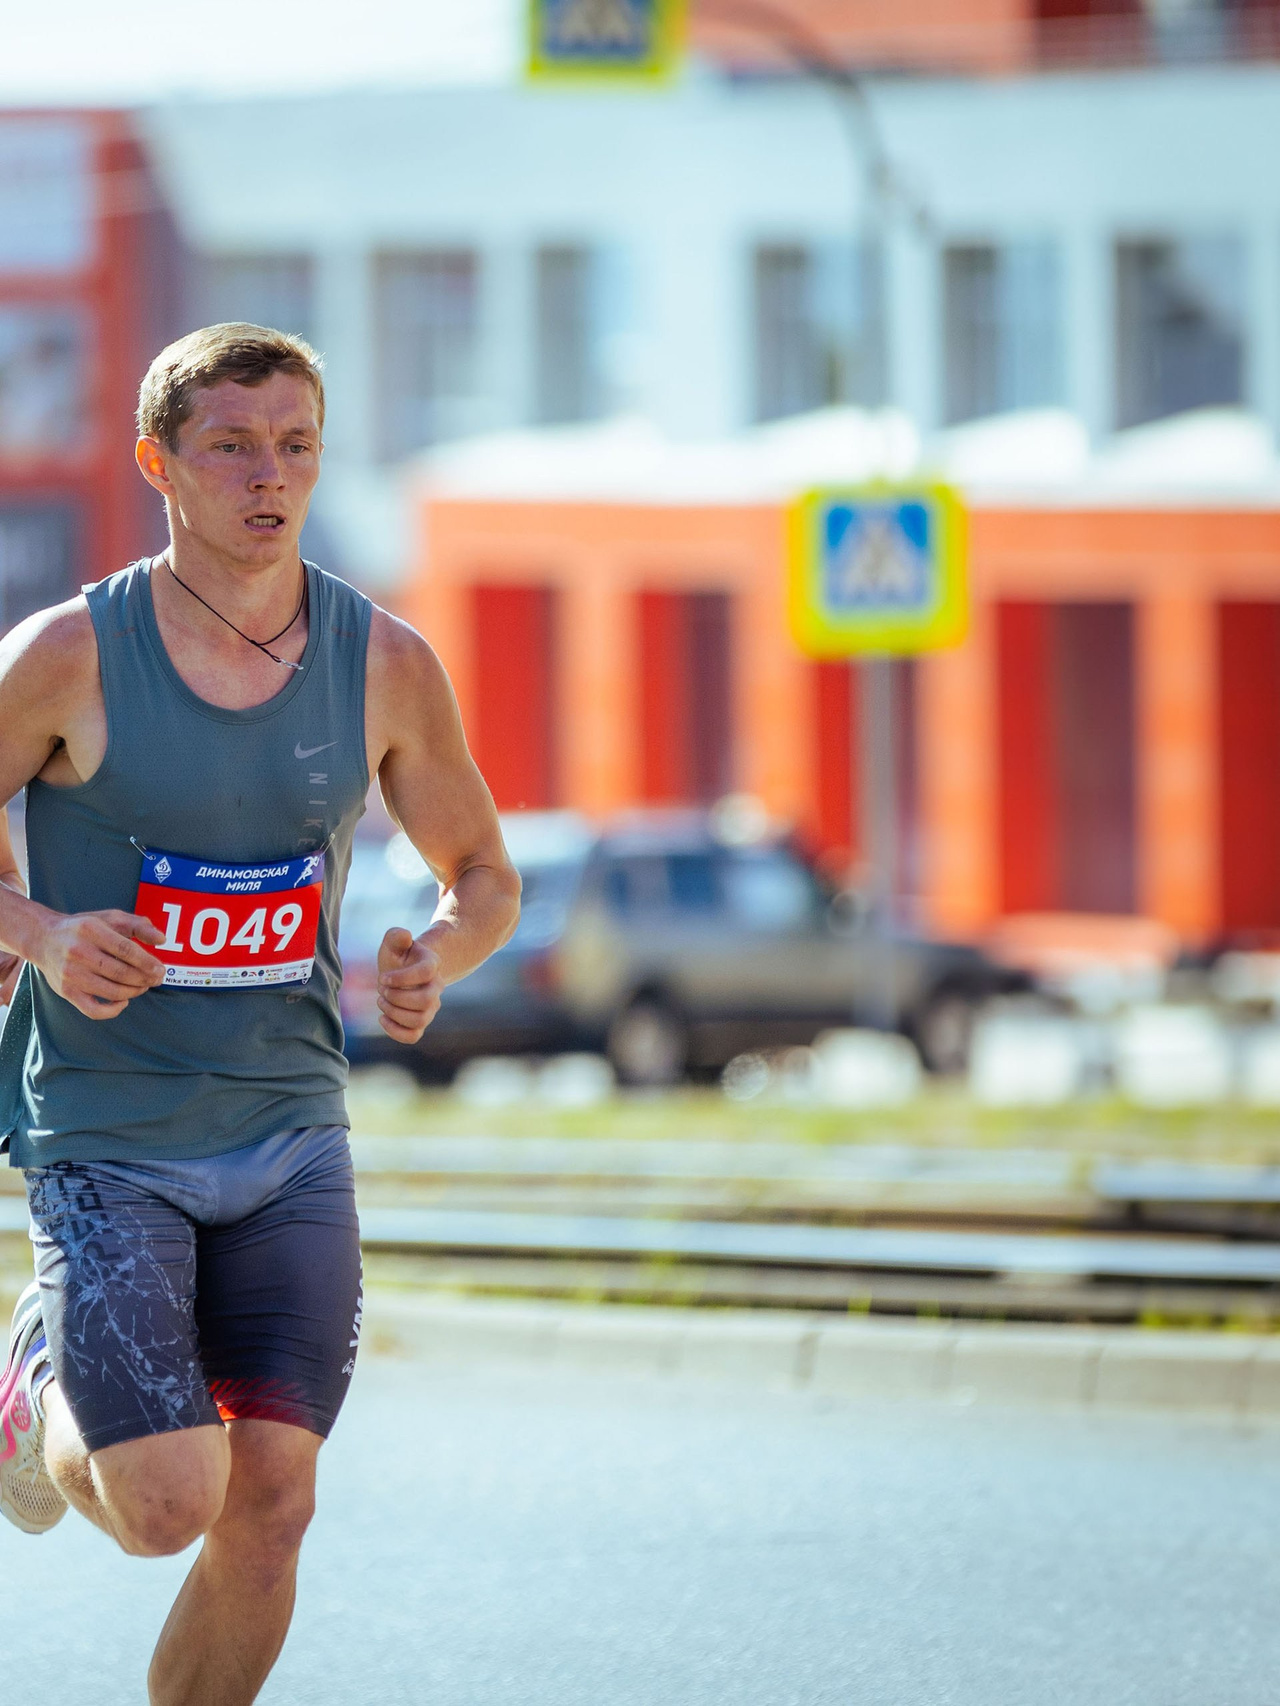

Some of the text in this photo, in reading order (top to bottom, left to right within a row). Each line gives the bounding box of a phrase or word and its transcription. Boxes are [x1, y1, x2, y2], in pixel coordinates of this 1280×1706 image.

[195, 865, 290, 879] ДИНАМОВСКАЯ
[225, 881, 261, 892] МИЛЯ
[155, 903, 303, 956] 1049
